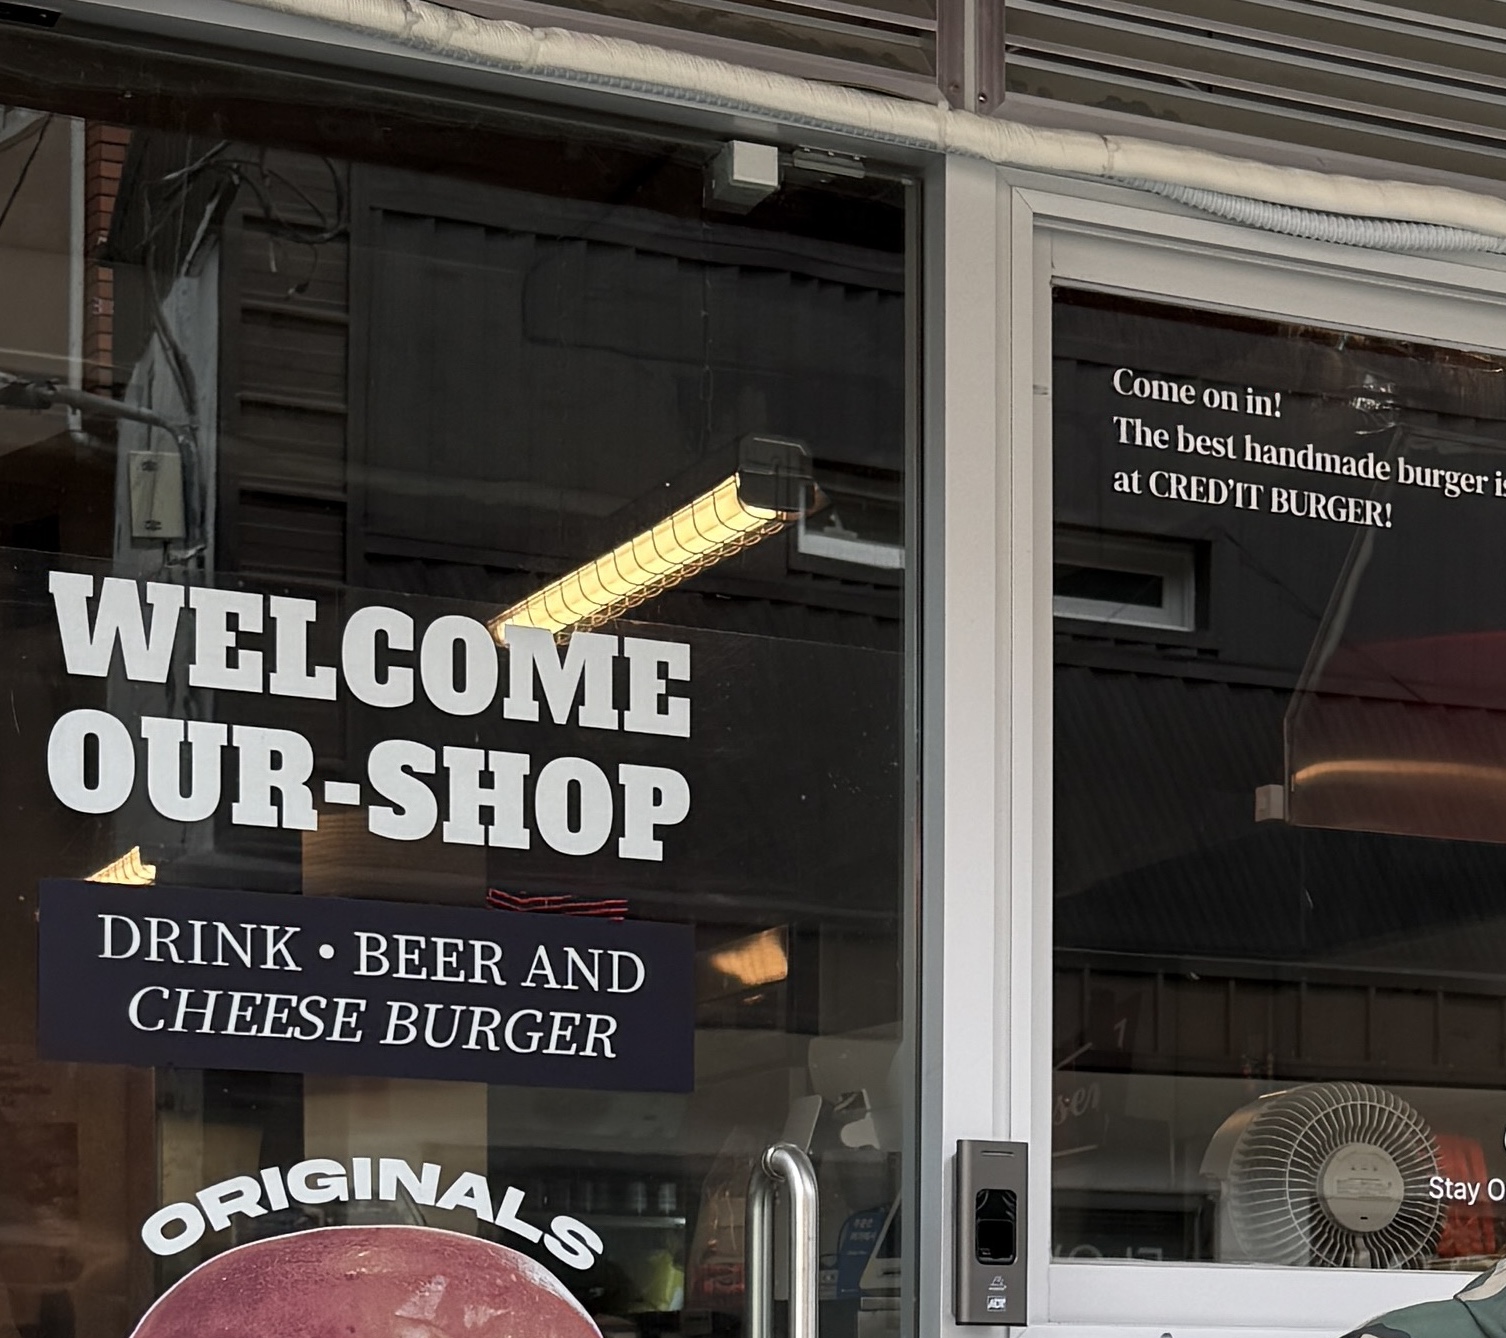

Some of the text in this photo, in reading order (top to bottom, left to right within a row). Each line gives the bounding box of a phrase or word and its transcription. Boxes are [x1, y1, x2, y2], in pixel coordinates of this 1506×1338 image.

[1112, 367, 1281, 417] Come on in!
[1113, 415, 1169, 450] The
[1176, 422, 1236, 461] best
[1244, 437, 1391, 482] handmade
[1397, 455, 1488, 498] burger
[1113, 469, 1392, 528] at CRED'IT BURGER!
[48, 570, 691, 738] WELCOME
[46, 709, 691, 861] OUR-SHOP
[97, 913, 645, 995] DRINK BEER AND
[128, 985, 617, 1059] CHEESE BURGER
[141, 1157, 605, 1271] ORIGINALS
[1429, 1176, 1480, 1205] Stay
